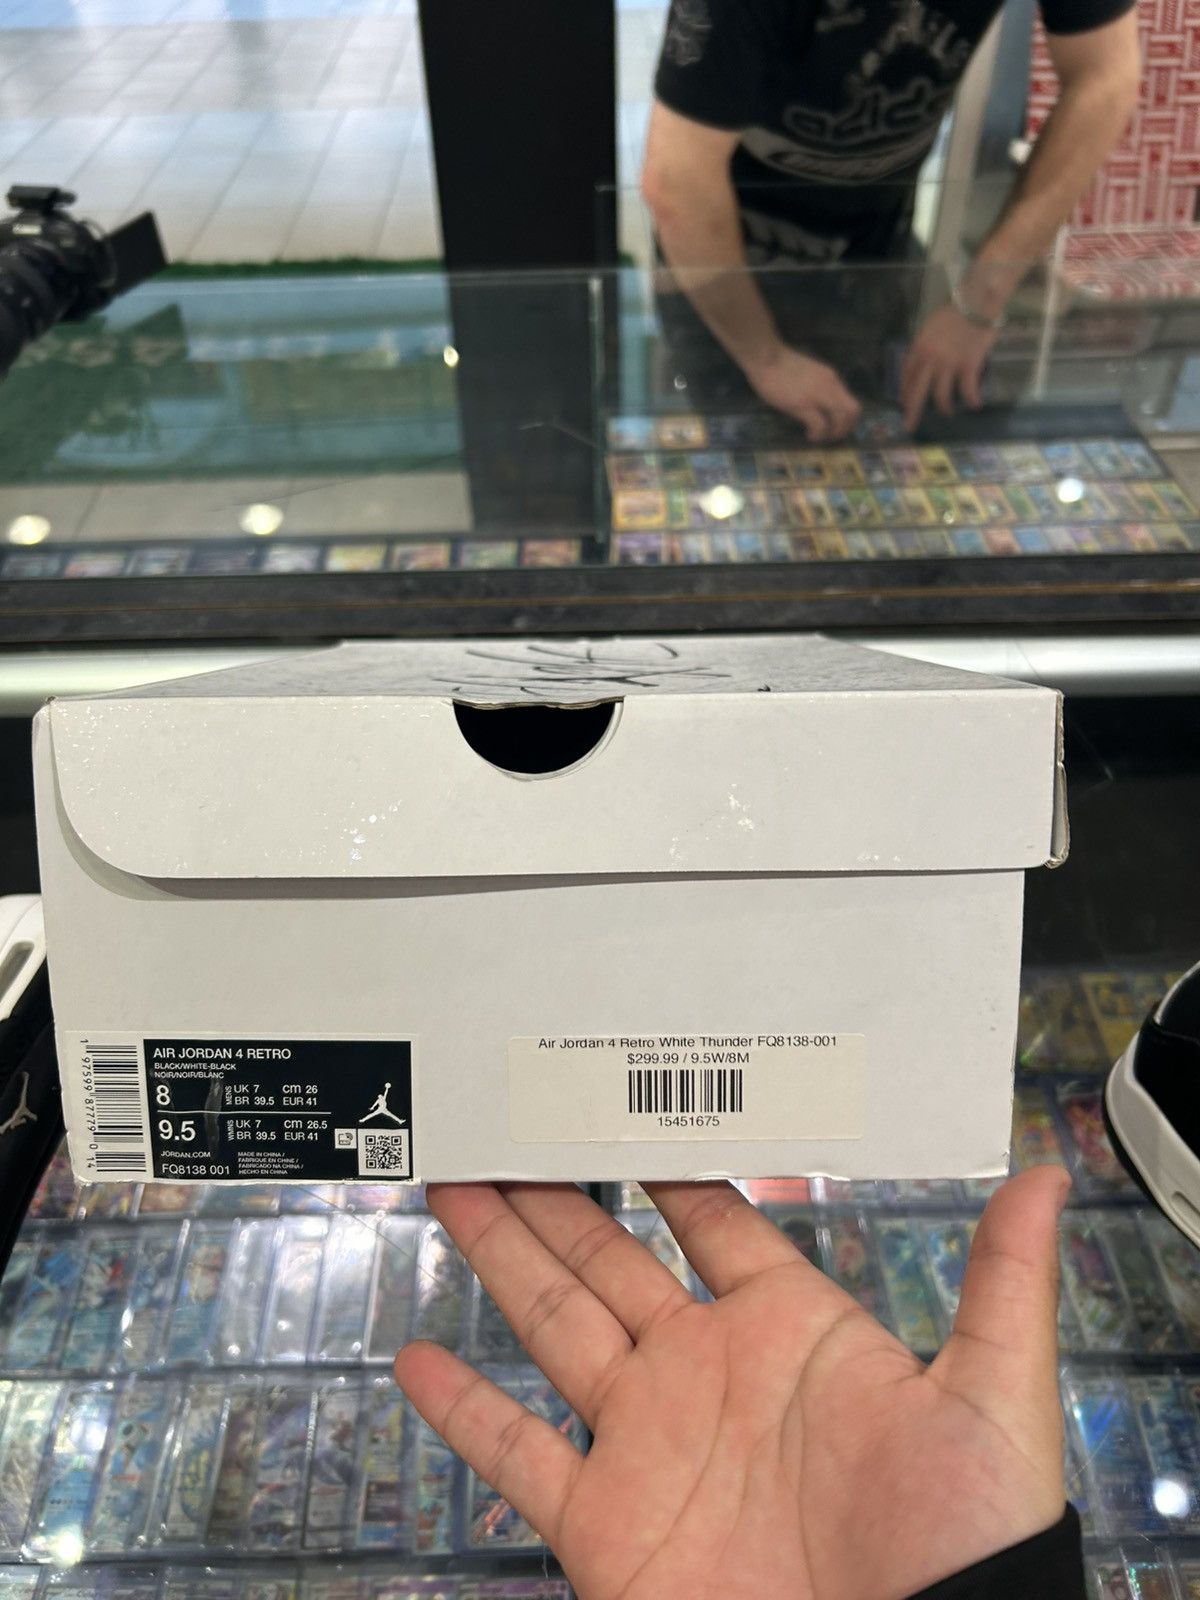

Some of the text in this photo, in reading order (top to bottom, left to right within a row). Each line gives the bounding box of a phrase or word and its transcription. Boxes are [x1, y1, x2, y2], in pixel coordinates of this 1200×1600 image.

[538, 1035, 837, 1049] Air Jordan 4 Retro White Thunder FQ8138-001
[153, 1047, 292, 1060] AIR JORDAN 4 RETRO
[627, 1052, 750, 1065] $299.99 / 9.5W/8M
[154, 1062, 237, 1071] BLACK/WHITE-BLACK
[81, 1057, 93, 1091] 97599
[154, 1071, 225, 1079] NOIR/NOIR/BLANC
[233, 1084, 260, 1093] UK 7
[305, 1084, 318, 1094] 26
[156, 1084, 171, 1106] 8
[225, 1085, 233, 1105] MENS
[234, 1096, 275, 1106] BR 39.5
[282, 1096, 318, 1106] EUR 41
[84, 1098, 97, 1132] 87779
[235, 1119, 262, 1129] UK 7
[306, 1120, 328, 1130] 26.5
[657, 1115, 720, 1127] 15451675
[158, 1119, 196, 1142] 9.5
[226, 1119, 235, 1142] WMNS
[236, 1131, 277, 1141] BR 39.5
[284, 1131, 319, 1141] EUR 41
[160, 1150, 211, 1159] JORDAN.COM
[161, 1163, 230, 1176] FQ8138 001
